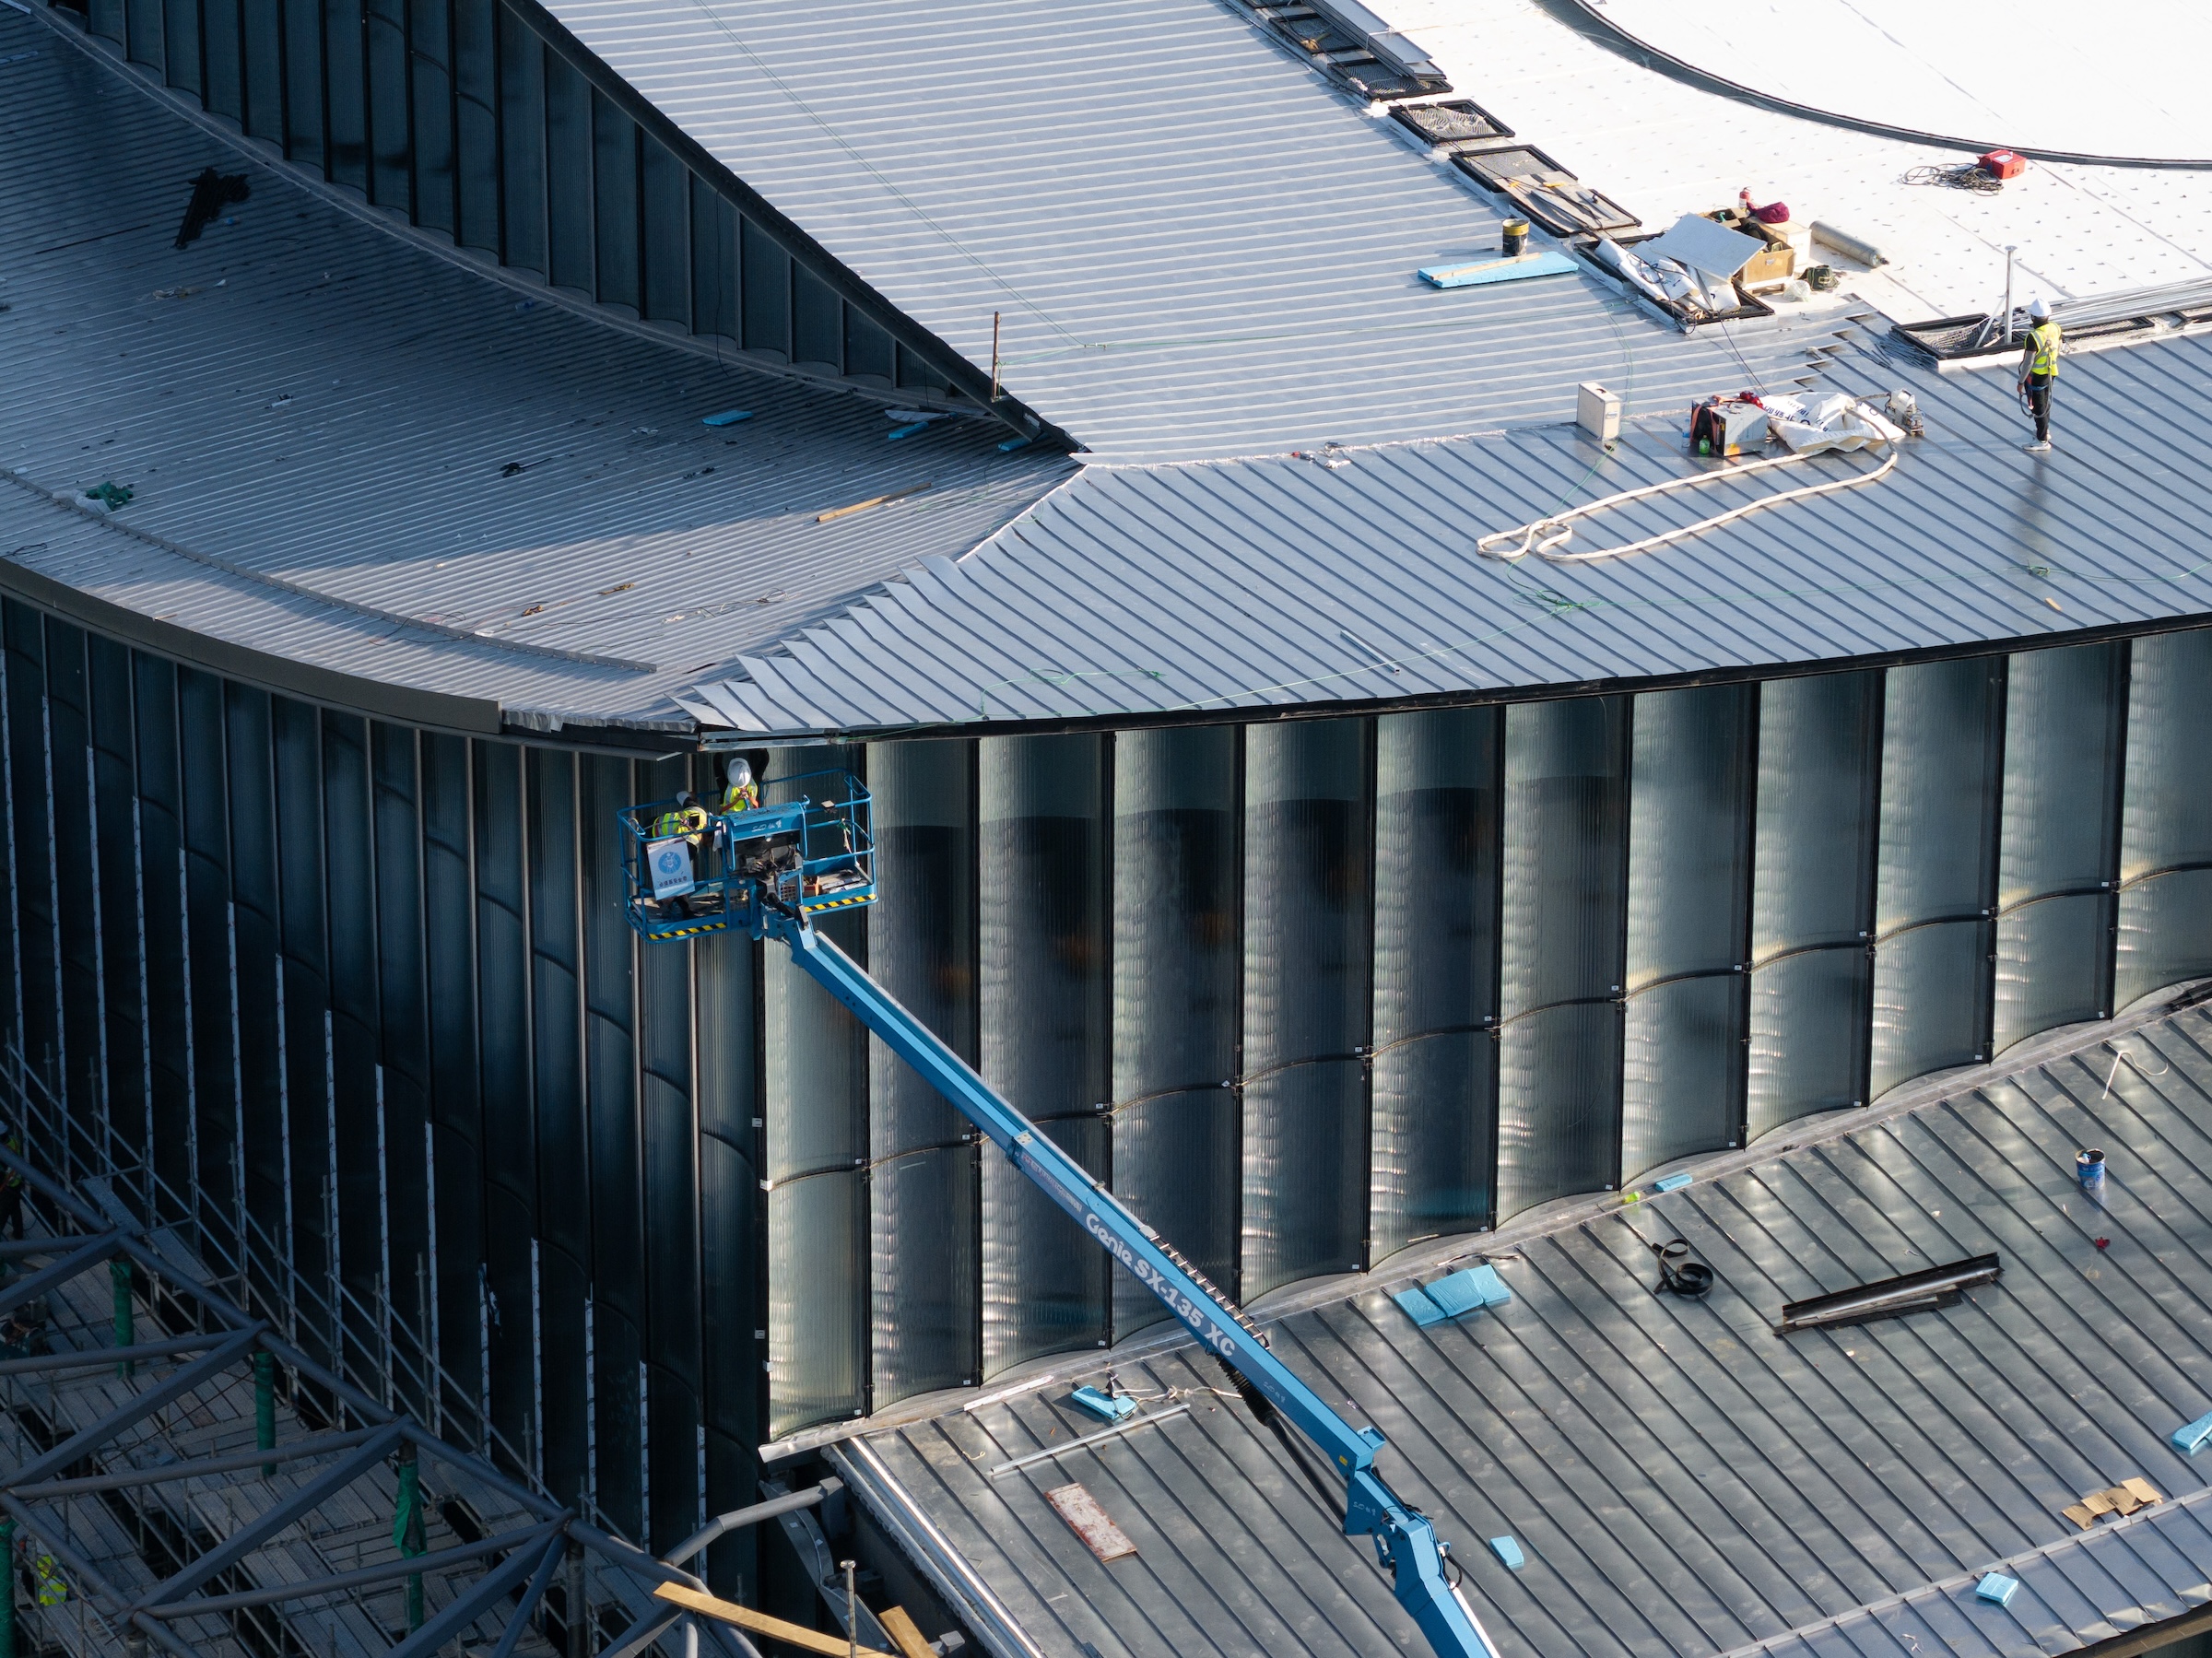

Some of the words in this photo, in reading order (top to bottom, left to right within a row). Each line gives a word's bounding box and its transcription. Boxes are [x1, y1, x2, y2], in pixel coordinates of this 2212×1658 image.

[1086, 1213, 1133, 1267] Genie
[1135, 1259, 1204, 1327] SX-135
[1205, 1322, 1235, 1357] XC
